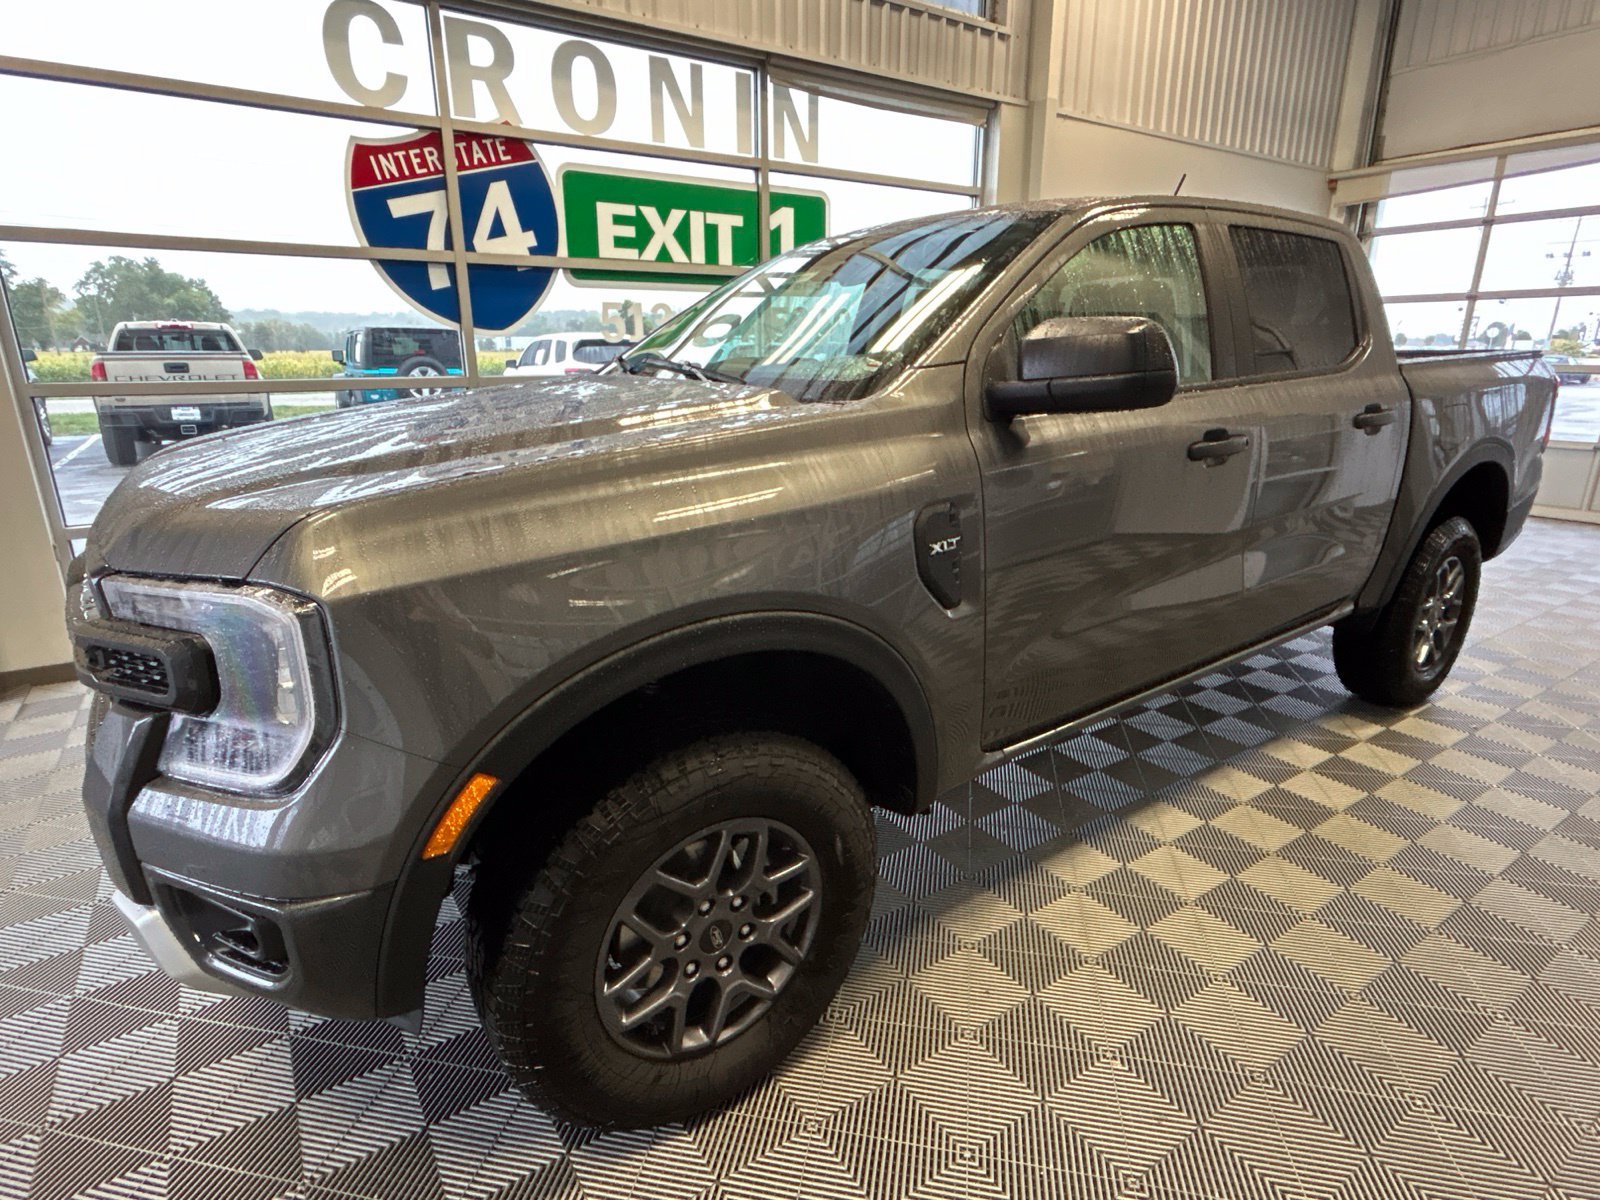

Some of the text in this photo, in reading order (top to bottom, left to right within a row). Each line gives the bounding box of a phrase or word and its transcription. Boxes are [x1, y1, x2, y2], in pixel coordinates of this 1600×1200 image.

[322, 0, 820, 163] CRONIN
[369, 138, 512, 181] INTERTATE
[386, 179, 538, 290] 74
[596, 201, 795, 266] EXIT 1
[929, 536, 961, 555] XLT
